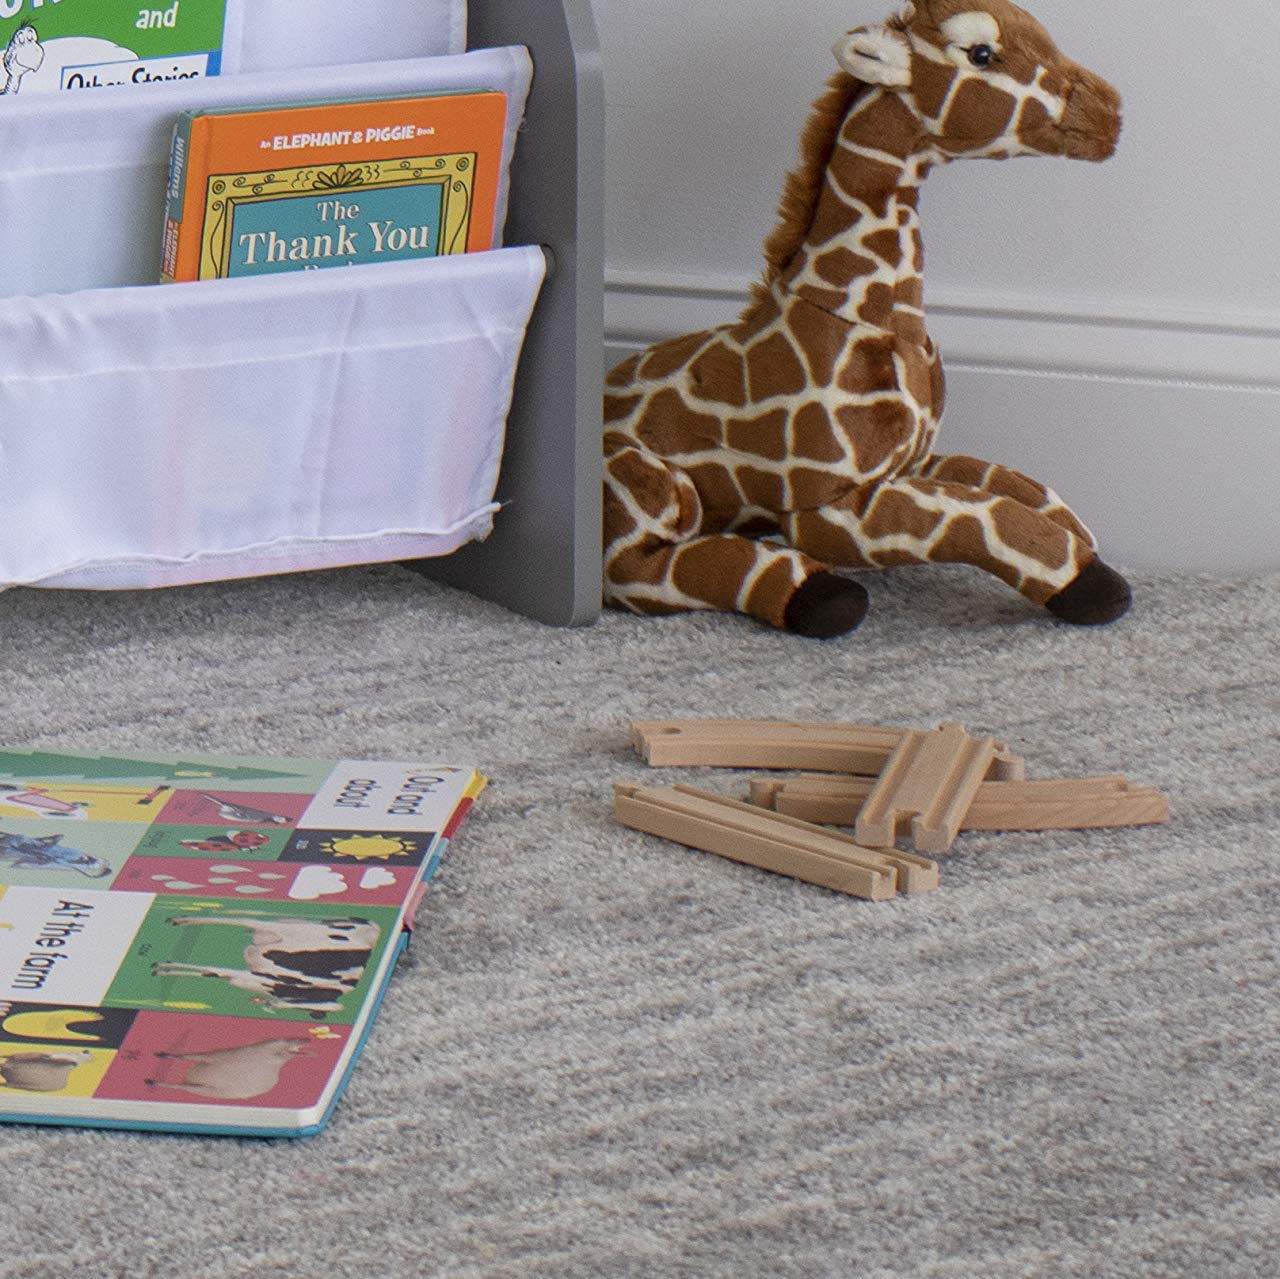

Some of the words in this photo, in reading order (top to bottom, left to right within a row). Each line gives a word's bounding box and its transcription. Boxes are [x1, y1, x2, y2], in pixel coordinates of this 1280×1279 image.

[135, 0, 180, 30] and
[272, 131, 353, 151] ELEPHANT
[352, 131, 364, 144] &
[365, 125, 416, 144] PIGGIE
[171, 136, 185, 199] Willems
[316, 200, 361, 222] The
[239, 224, 360, 266] Thank
[368, 220, 430, 253] You
[333, 778, 383, 809] about
[401, 775, 446, 793] Out
[386, 793, 424, 816] and
[51, 899, 96, 918] At
[35, 922, 86, 948] the
[11, 951, 69, 990] farm
